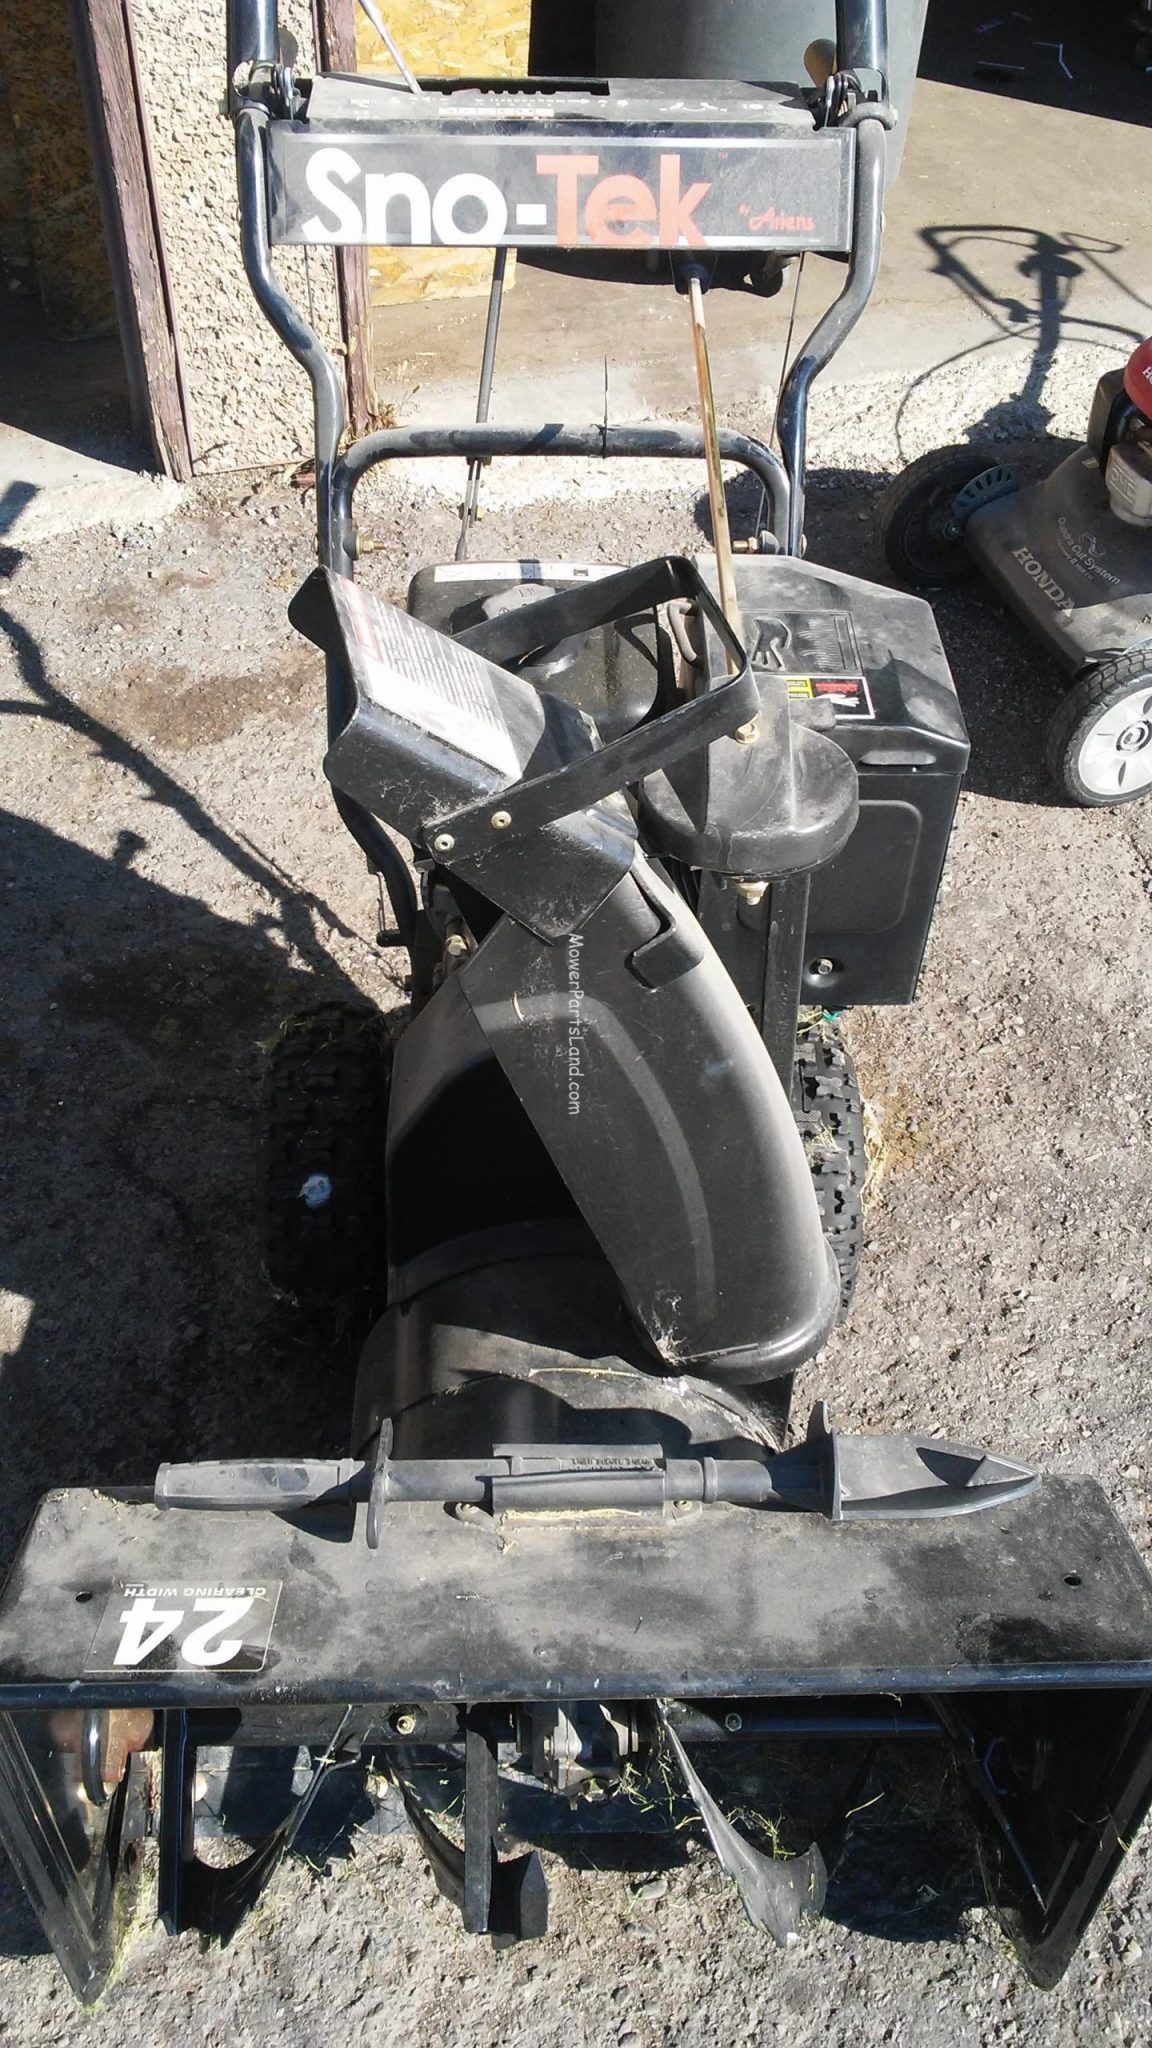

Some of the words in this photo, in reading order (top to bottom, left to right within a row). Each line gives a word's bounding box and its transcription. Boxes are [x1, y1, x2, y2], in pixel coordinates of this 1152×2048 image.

[301, 147, 712, 247] Sno-Tek
[748, 206, 816, 232] Ariens
[1012, 546, 1075, 618] HONDA
[1084, 557, 1121, 585] System
[124, 1587, 177, 1597] WIDTH
[183, 1587, 267, 1597] CLEARING
[113, 1598, 255, 1666] 24
